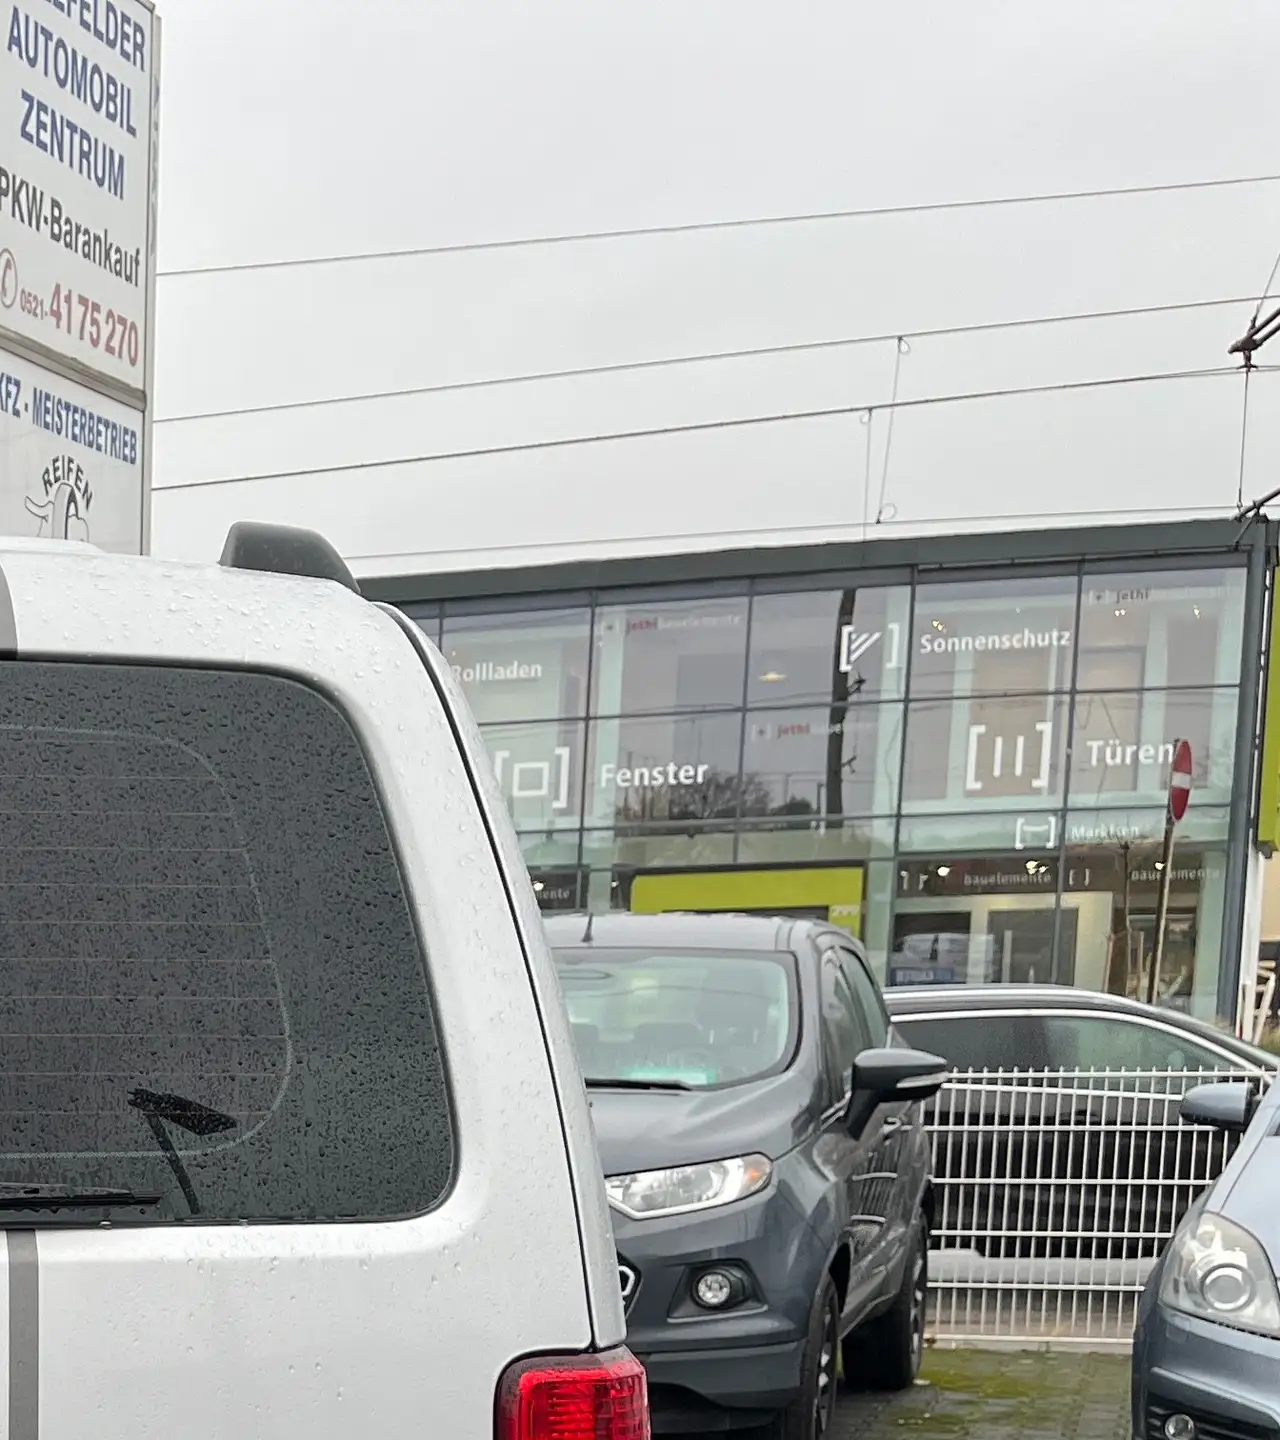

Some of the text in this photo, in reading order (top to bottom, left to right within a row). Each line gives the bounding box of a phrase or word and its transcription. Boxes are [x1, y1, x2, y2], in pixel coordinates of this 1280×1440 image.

[7, 5, 137, 138] AUTOMOBIL
[20, 89, 125, 201] ZENTRUM
[32, 386, 137, 465] MEISTERBETRIEB
[42, 454, 92, 511] REIFEN
[920, 628, 1072, 654] Sonnenschutz
[600, 761, 709, 789] Fenster
[1086, 738, 1175, 767] Türen
